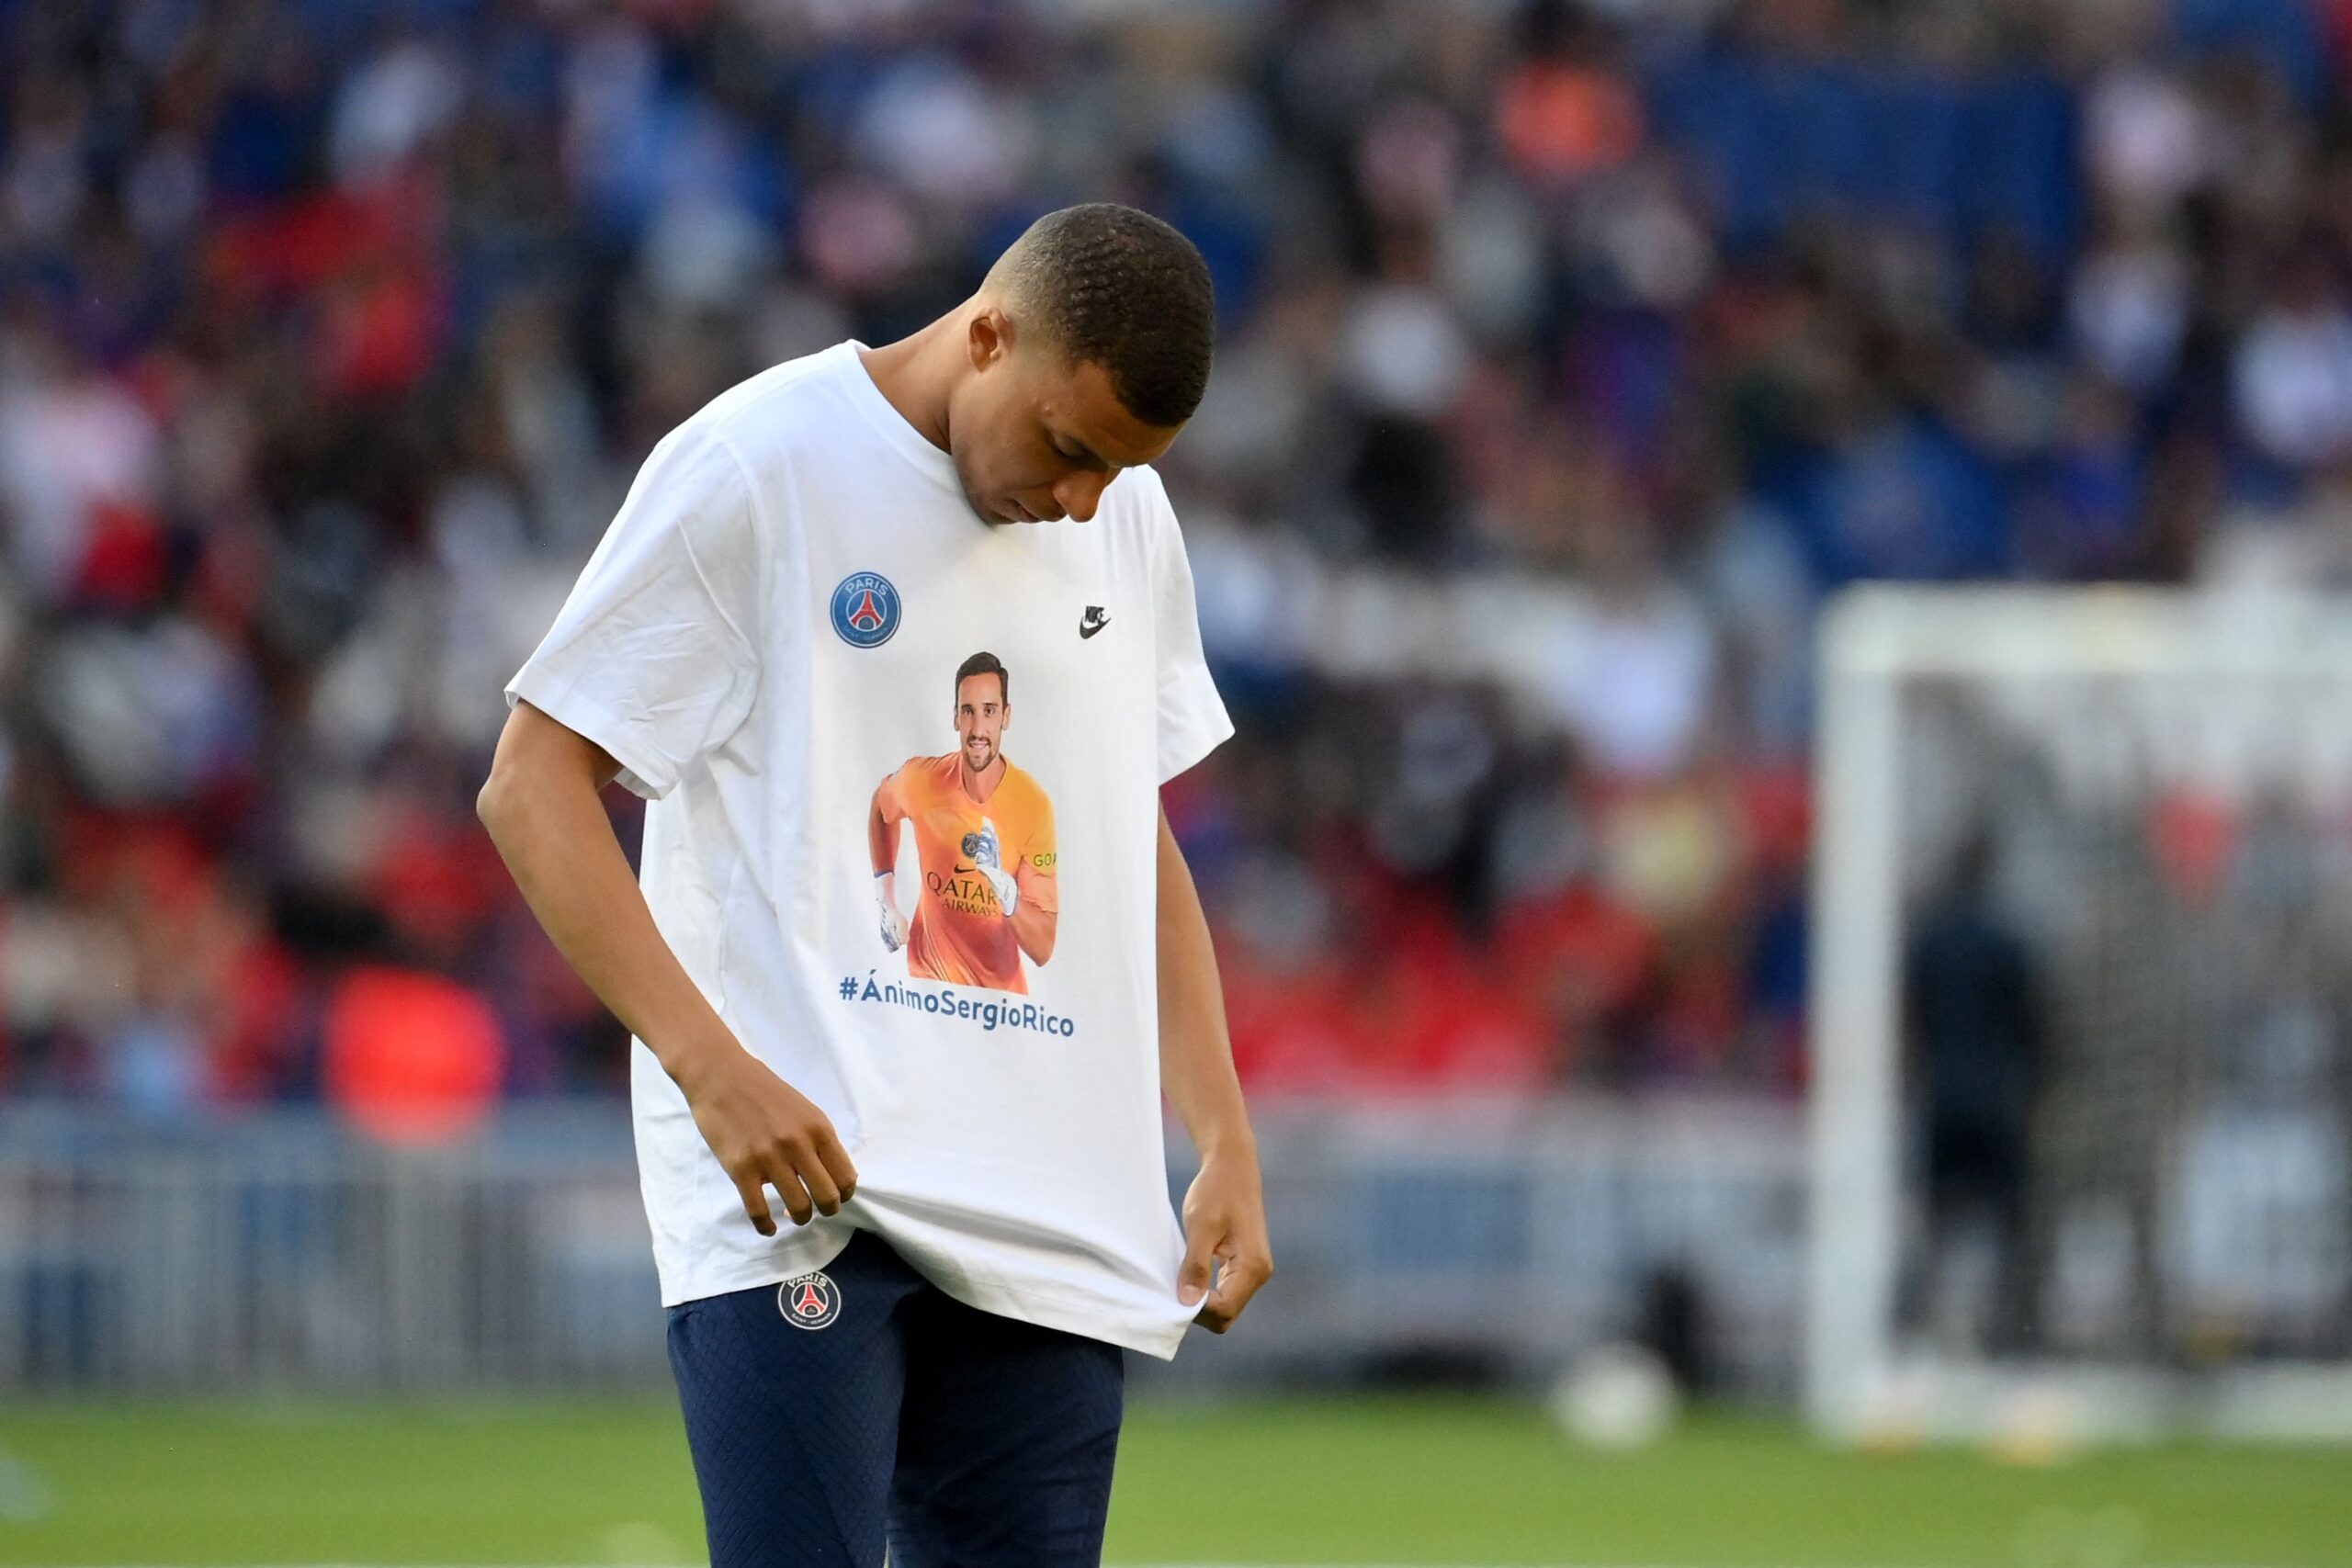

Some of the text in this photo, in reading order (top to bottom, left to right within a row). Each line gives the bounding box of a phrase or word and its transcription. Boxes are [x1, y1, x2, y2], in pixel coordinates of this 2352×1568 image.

[845, 578, 888, 595] PARIS
[943, 898, 999, 917] AIRWAYS
[840, 969, 1074, 1037] #ÁnimoSergioRico
